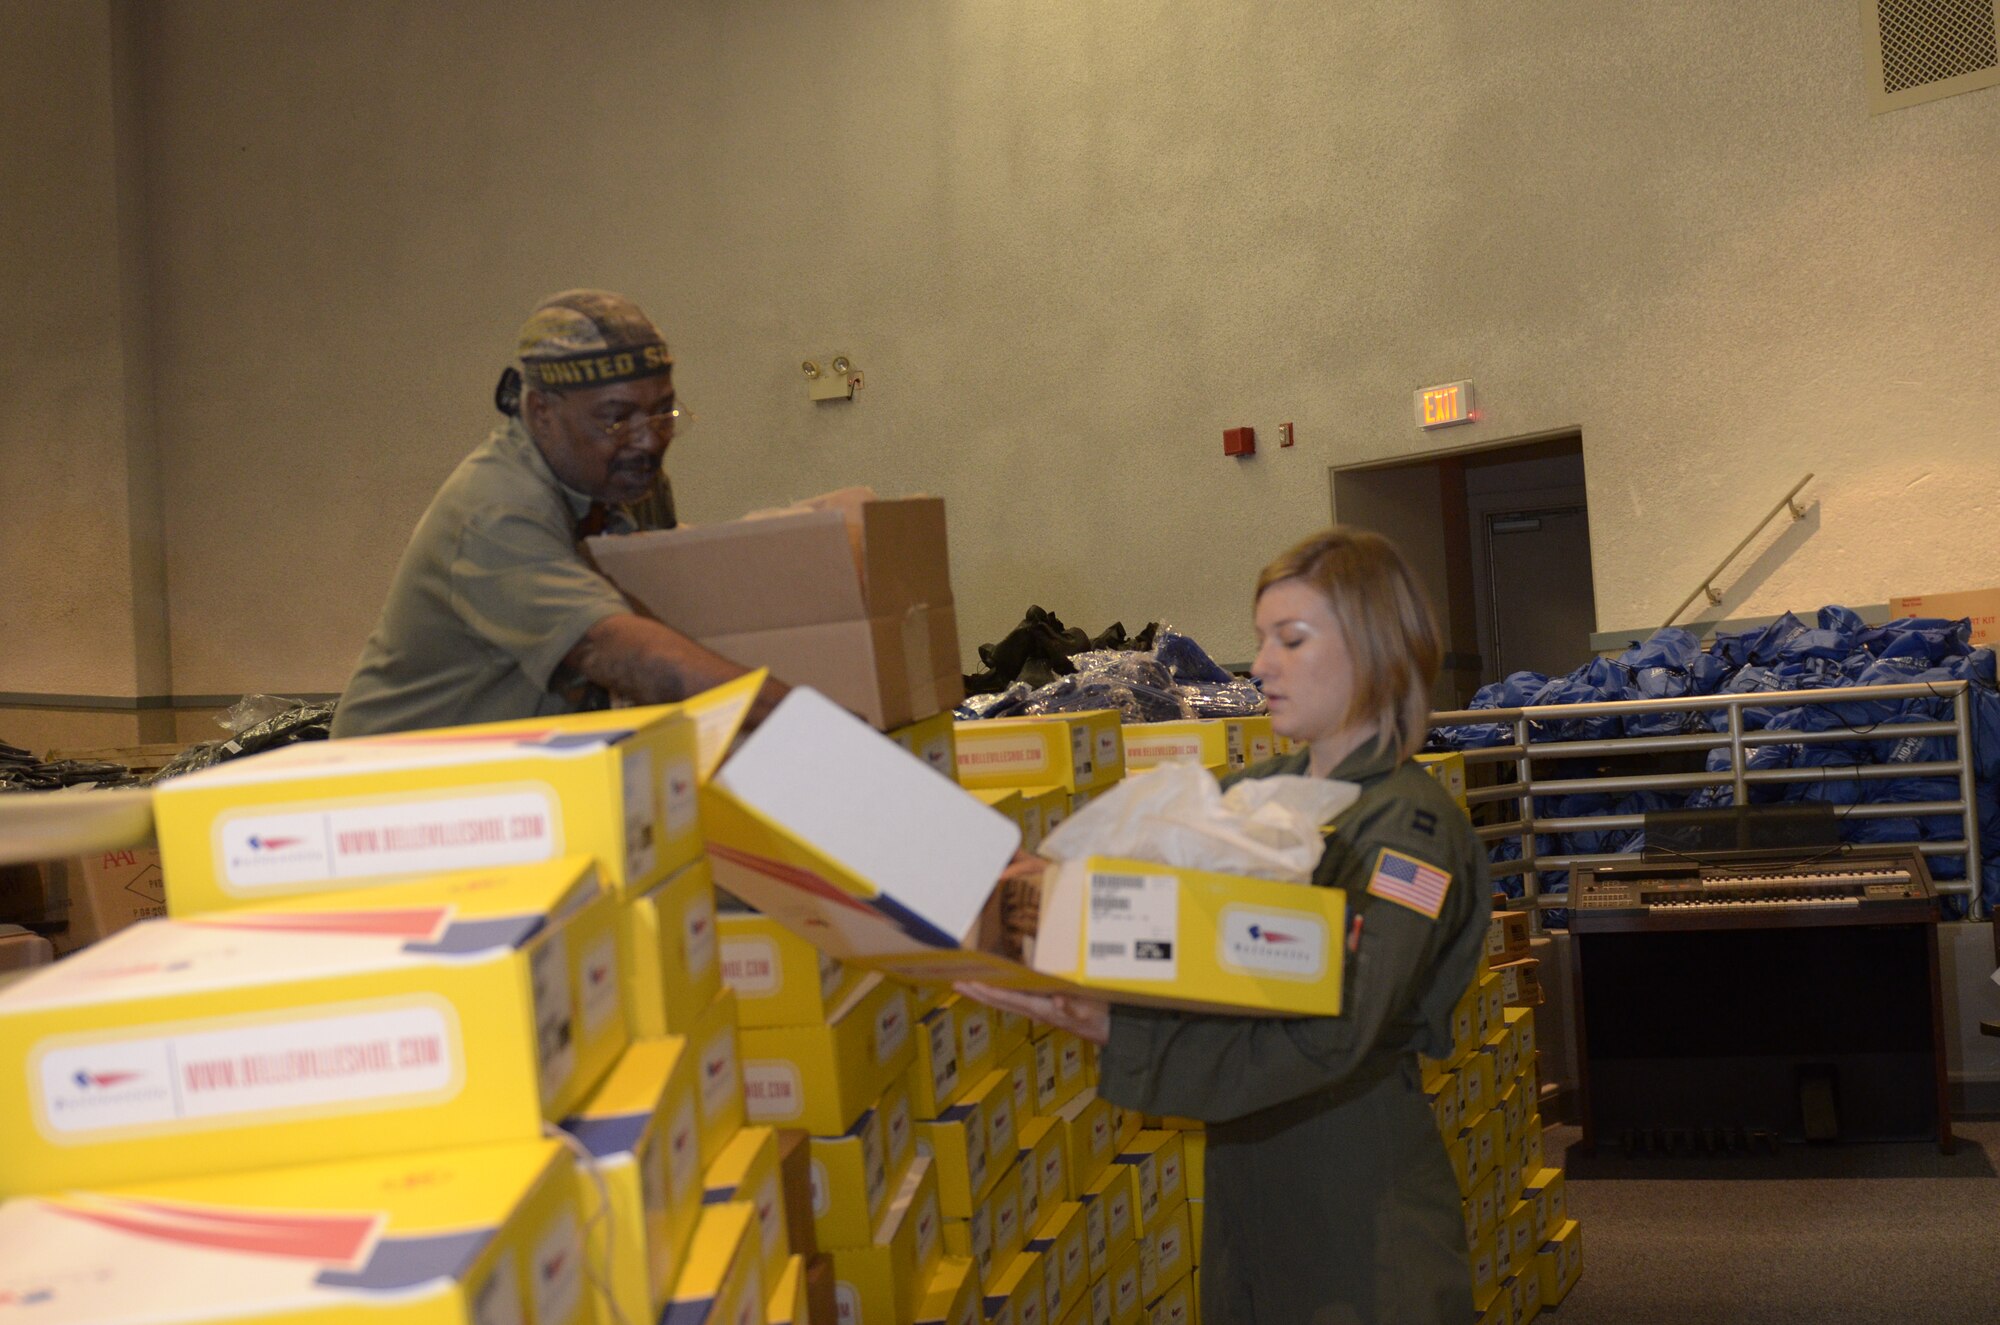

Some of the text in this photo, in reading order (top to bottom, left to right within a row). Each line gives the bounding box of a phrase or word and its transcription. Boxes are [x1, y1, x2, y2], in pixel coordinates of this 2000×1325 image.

[540, 352, 635, 385] UNITED
[1423, 386, 1458, 425] EXIT
[1982, 615, 1995, 624] KIT
